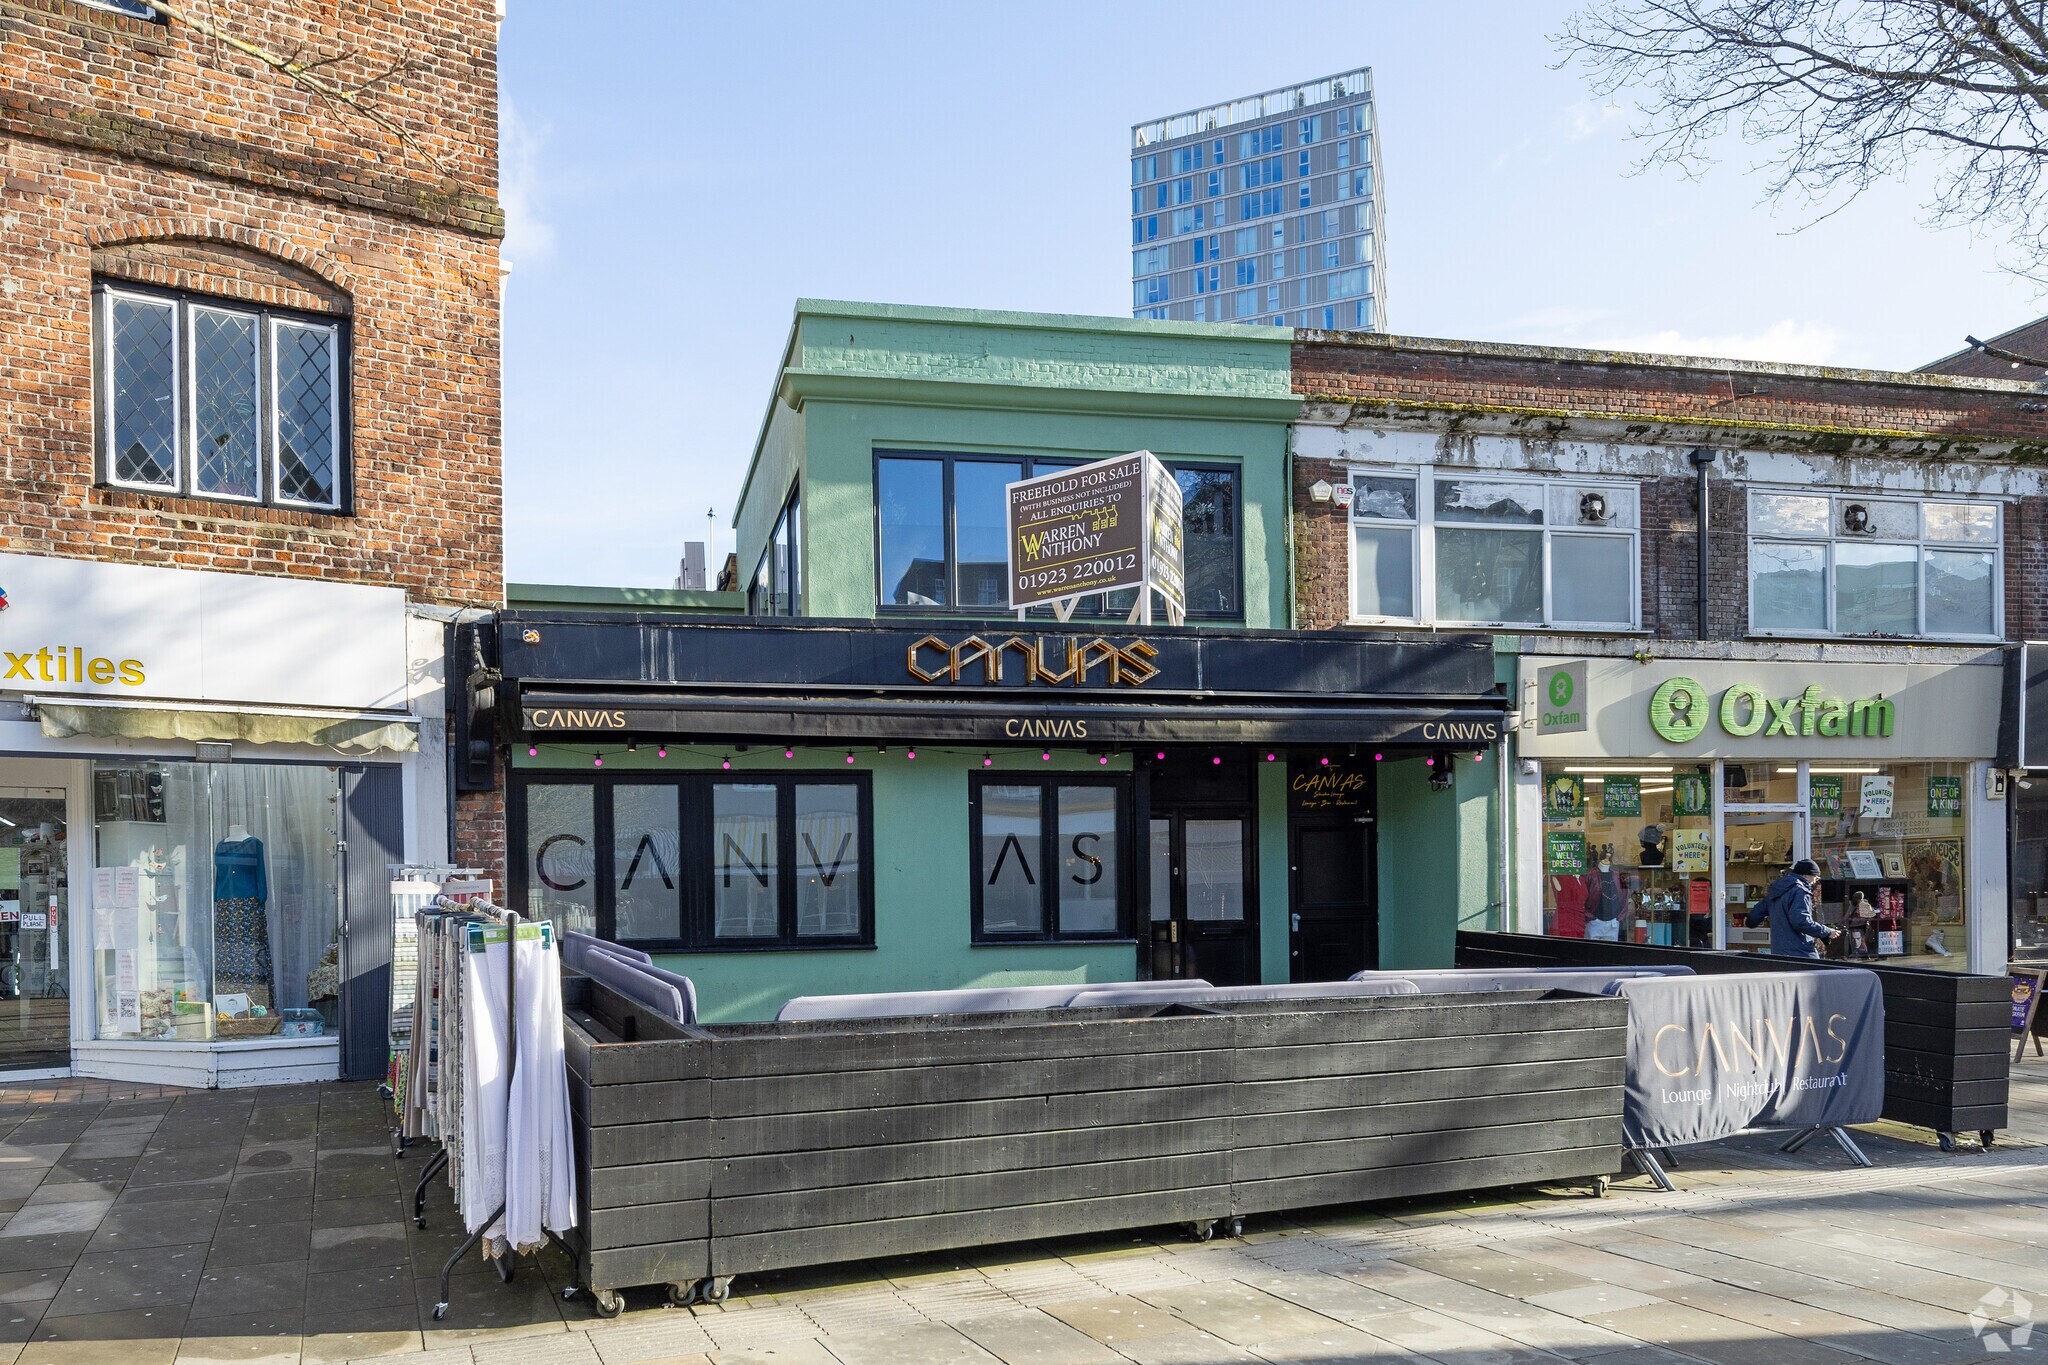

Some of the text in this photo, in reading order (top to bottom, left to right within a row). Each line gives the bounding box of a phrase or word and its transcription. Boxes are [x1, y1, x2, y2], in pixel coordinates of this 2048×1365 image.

[1012, 462, 1141, 504] FREEHOLD FOR SALE
[1019, 480, 1132, 514] (WITH BUSINESS NOT INCLUDED)
[1030, 492, 1122, 522] ALL ENQUIRIES TO
[1021, 522, 1086, 553] WARREN
[1027, 532, 1104, 562] ANTHONY
[1018, 554, 1137, 590] 01923 220012
[1036, 574, 1117, 596] www.warrenanthony.co.uk
[3, 645, 146, 686] xtiles
[908, 634, 1162, 686] CANVAS
[532, 709, 627, 728] CANVAS
[1542, 711, 1580, 727] Oxfam
[1719, 683, 1896, 738] Oxfam
[1005, 718, 1088, 738] CANVAS
[1423, 722, 1498, 740] CANVAS
[1292, 772, 1367, 792] CANVAS
[1810, 787, 1841, 799] ONE OF
[1863, 789, 1893, 798] VOLUNTEER
[1930, 787, 1959, 799] ONE OF
[1810, 799, 1840, 810] A KIND
[1931, 799, 1959, 810] A KIND
[1552, 843, 1580, 852] ALWAYS
[1675, 842, 1709, 852] VOLUNTEER
[1684, 851, 1701, 859] HERE
[1552, 860, 1582, 868] DRESSED
[1653, 1013, 1847, 1077] CANVAS
[1662, 1084, 1712, 1105] Lounge
[1792, 1072, 1848, 1092] Restaurant
